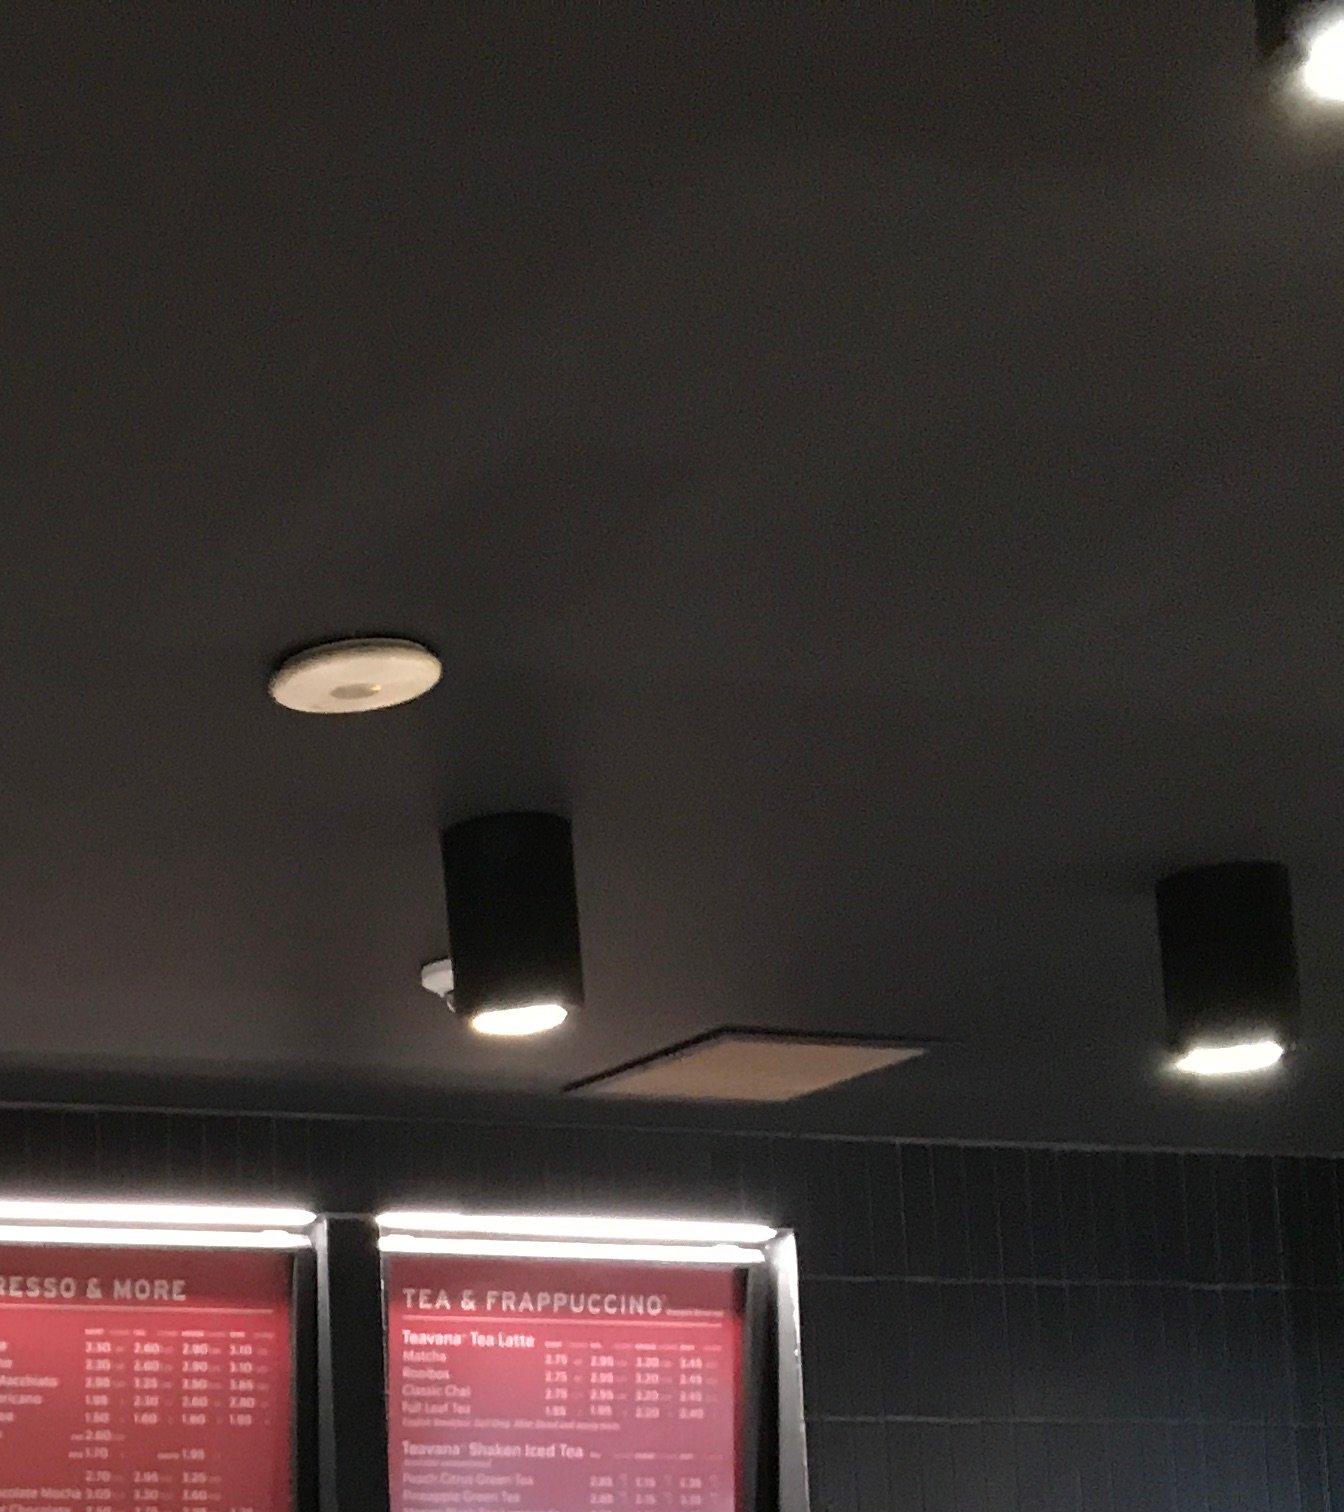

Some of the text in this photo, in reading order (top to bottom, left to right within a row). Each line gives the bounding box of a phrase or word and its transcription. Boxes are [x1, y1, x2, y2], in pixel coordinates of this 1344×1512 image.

[85, 1277, 102, 1299] &
[113, 1279, 187, 1301] MORE
[402, 1288, 662, 1316] TEA & FRAPPUCCINO
[470, 1331, 494, 1347] Tea
[498, 1332, 535, 1348] Latte
[469, 1441, 521, 1457] Shaken
[525, 1443, 555, 1457] Iced
[560, 1443, 583, 1459] Tea
